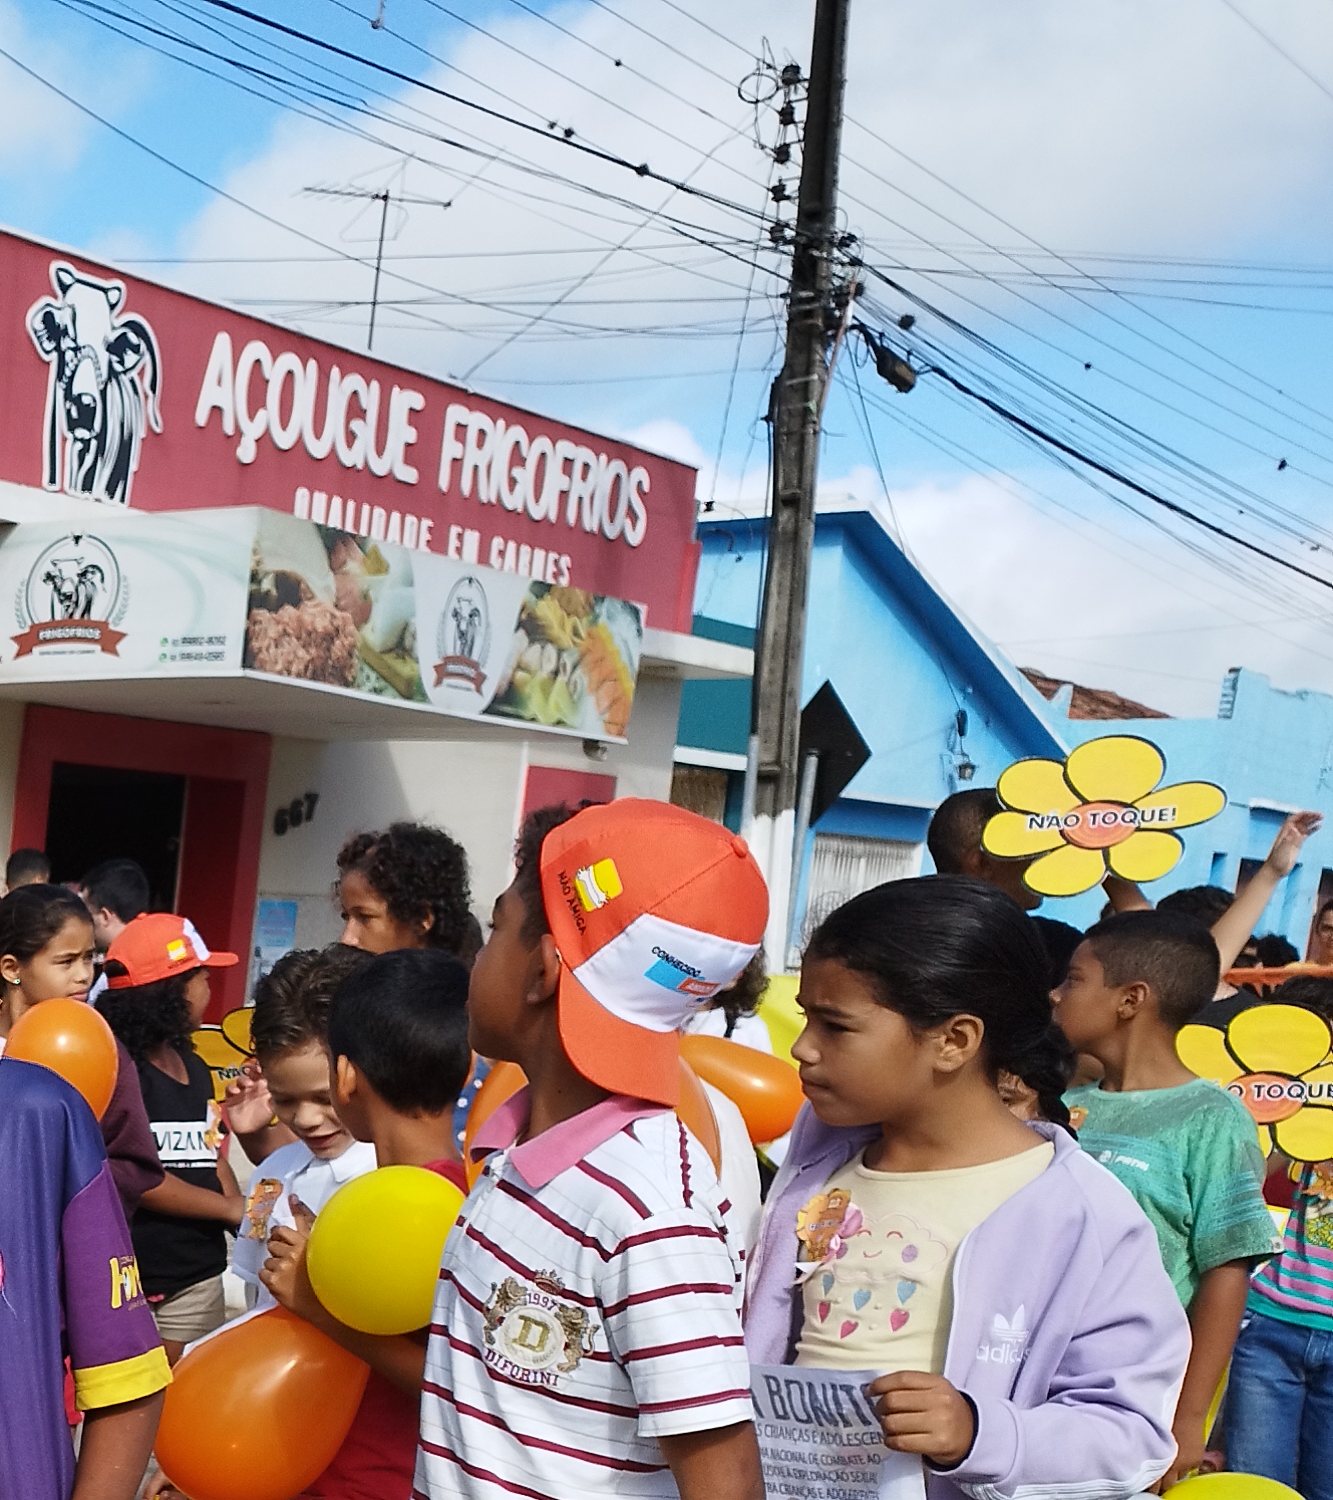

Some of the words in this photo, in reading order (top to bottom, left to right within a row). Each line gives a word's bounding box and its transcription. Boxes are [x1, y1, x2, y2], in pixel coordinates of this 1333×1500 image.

[194, 331, 426, 485] AÇOUGUE
[438, 402, 651, 547] FRIGOFRIOS
[1027, 810, 1081, 830] NÃO
[1088, 806, 1177, 829] TOQUE!
[527, 1292, 558, 1312] 1997
[511, 1313, 551, 1352] D
[485, 1349, 560, 1387] DIFORINI
[819, 1431, 884, 1447] ADOLESCEN
